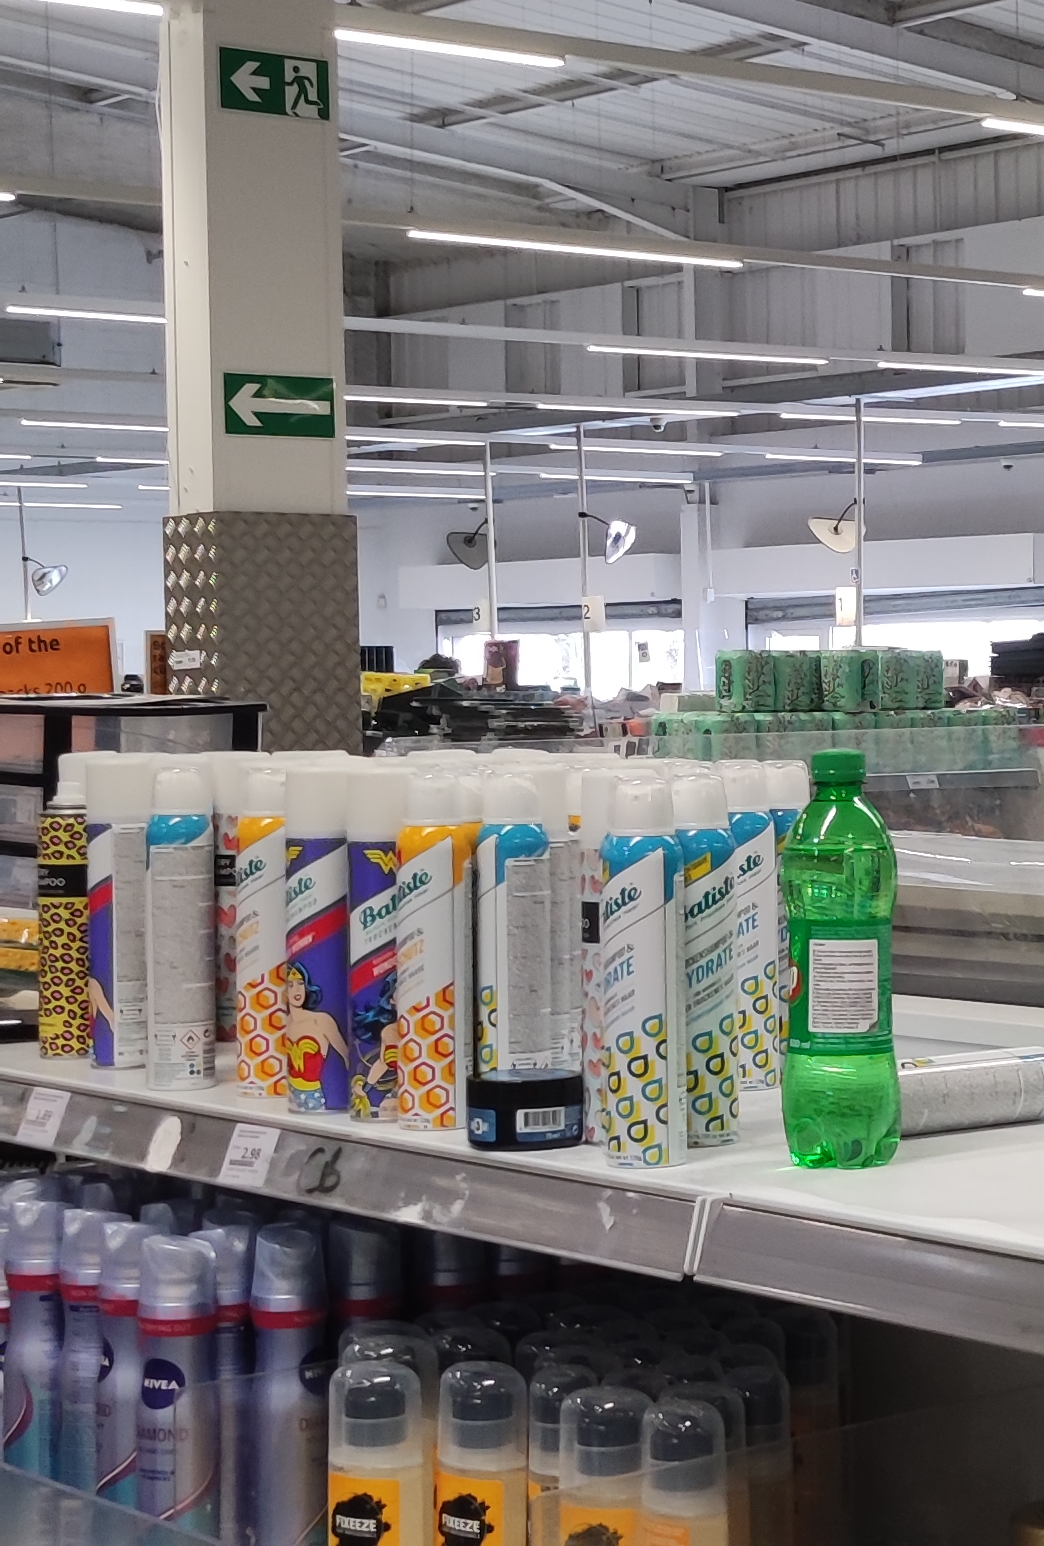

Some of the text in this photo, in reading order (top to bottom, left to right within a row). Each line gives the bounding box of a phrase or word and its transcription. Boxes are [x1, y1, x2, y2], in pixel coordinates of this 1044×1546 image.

[2, 634, 61, 655] of the
[143, 1377, 179, 1391] NIVEA
[335, 1514, 377, 1532] FIXEEZE
[441, 1513, 481, 1534] FIXEEZE
